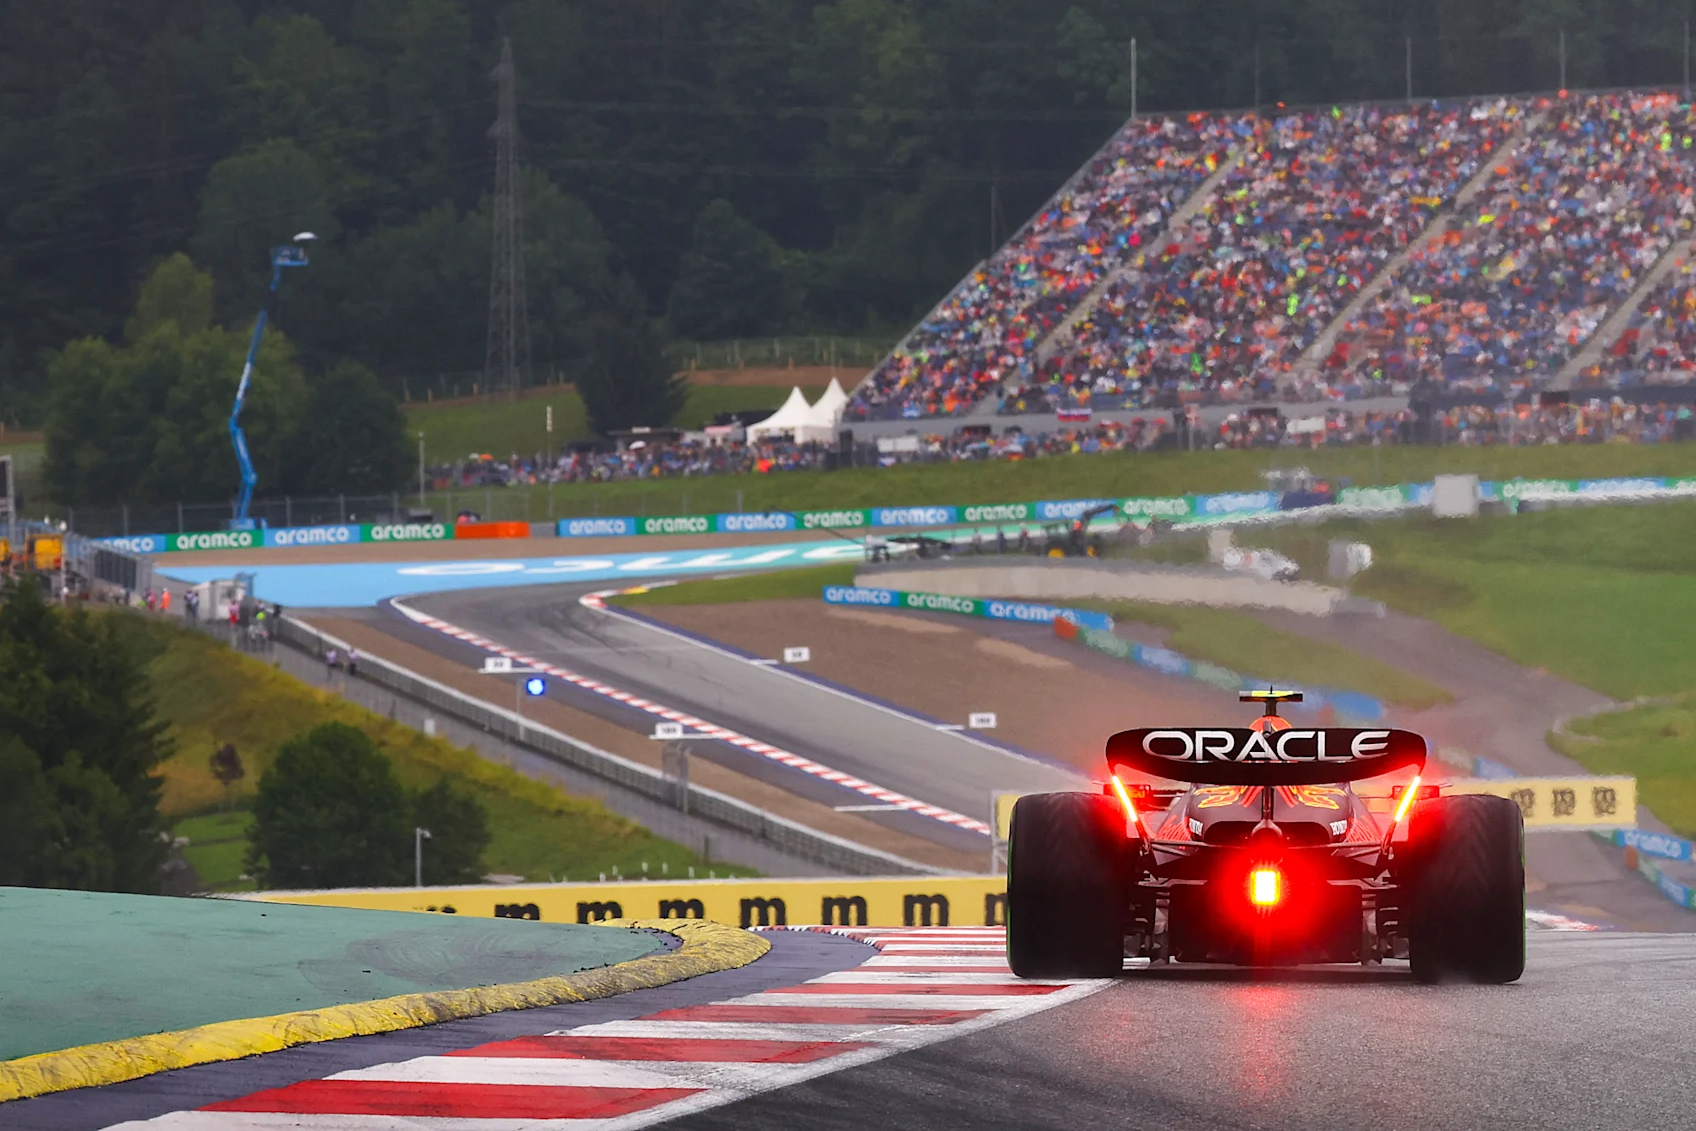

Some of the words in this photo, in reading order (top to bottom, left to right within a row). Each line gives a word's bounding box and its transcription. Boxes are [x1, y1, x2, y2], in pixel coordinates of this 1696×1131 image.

[569, 519, 626, 536] aramco
[645, 517, 709, 533] aramco
[725, 513, 787, 531] aramco
[803, 510, 864, 529] aramco
[880, 507, 948, 526] aramco
[965, 504, 1028, 522] aramco
[176, 532, 252, 550] aramco
[275, 525, 350, 545] aramco
[371, 523, 445, 541] aramco
[826, 586, 892, 605] aramco
[907, 593, 975, 613] aramco
[1142, 730, 1391, 762] ORACLE
[739, 897, 786, 929] m
[822, 895, 867, 927] m
[903, 893, 949, 927] m
